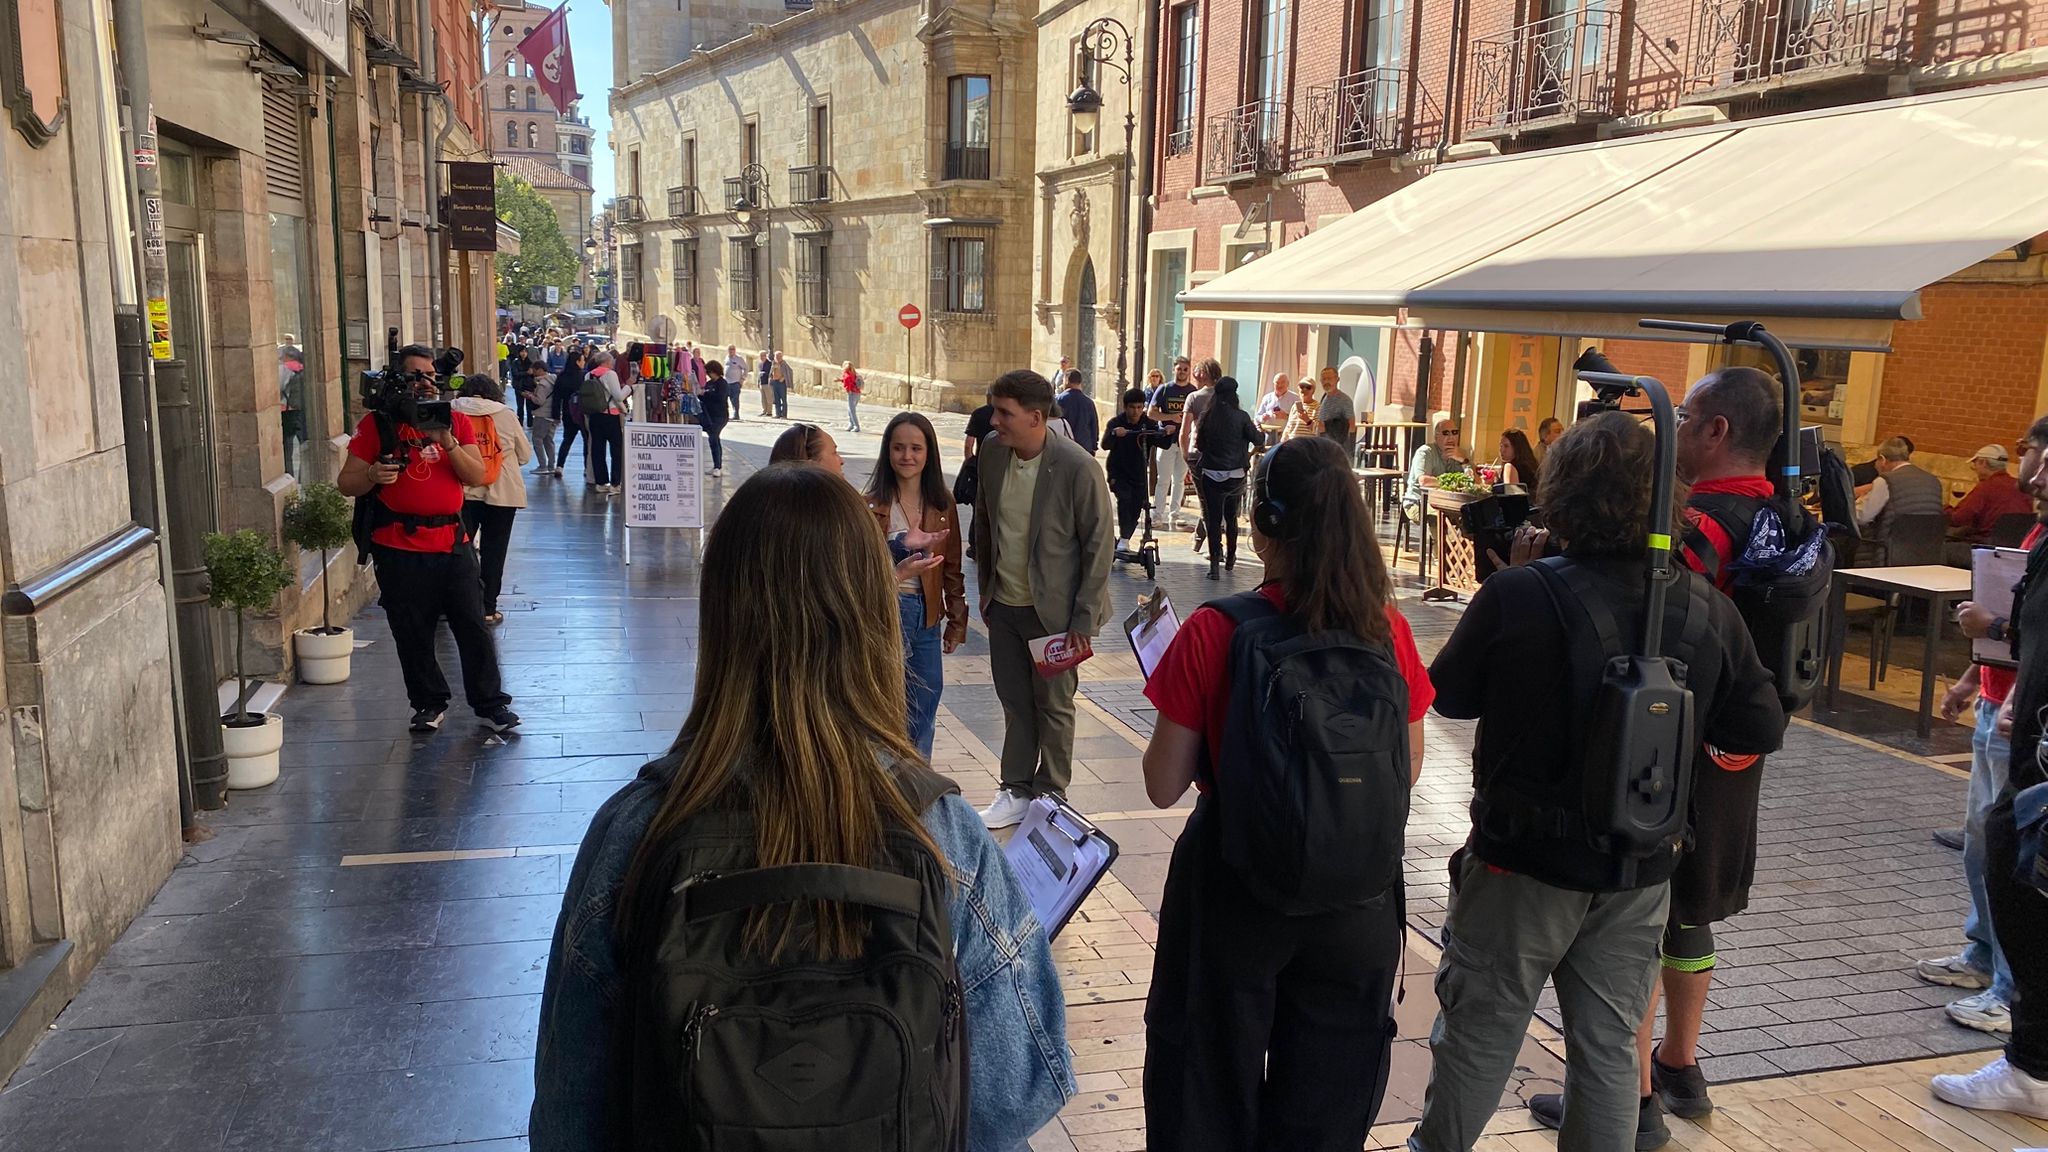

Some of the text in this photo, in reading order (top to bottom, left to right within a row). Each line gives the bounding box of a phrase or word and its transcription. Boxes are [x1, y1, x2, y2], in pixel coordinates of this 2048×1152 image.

[1512, 335, 1535, 430] TAURA
[631, 432, 667, 447] HELADOS
[638, 463, 663, 471] VAINILLA
[638, 473, 660, 481] CARAMELO
[638, 483, 666, 491] AVELLANA
[638, 493, 670, 501] CHOCOLATE
[638, 503, 656, 511] FRESA
[638, 512, 656, 521] LIMÓN
